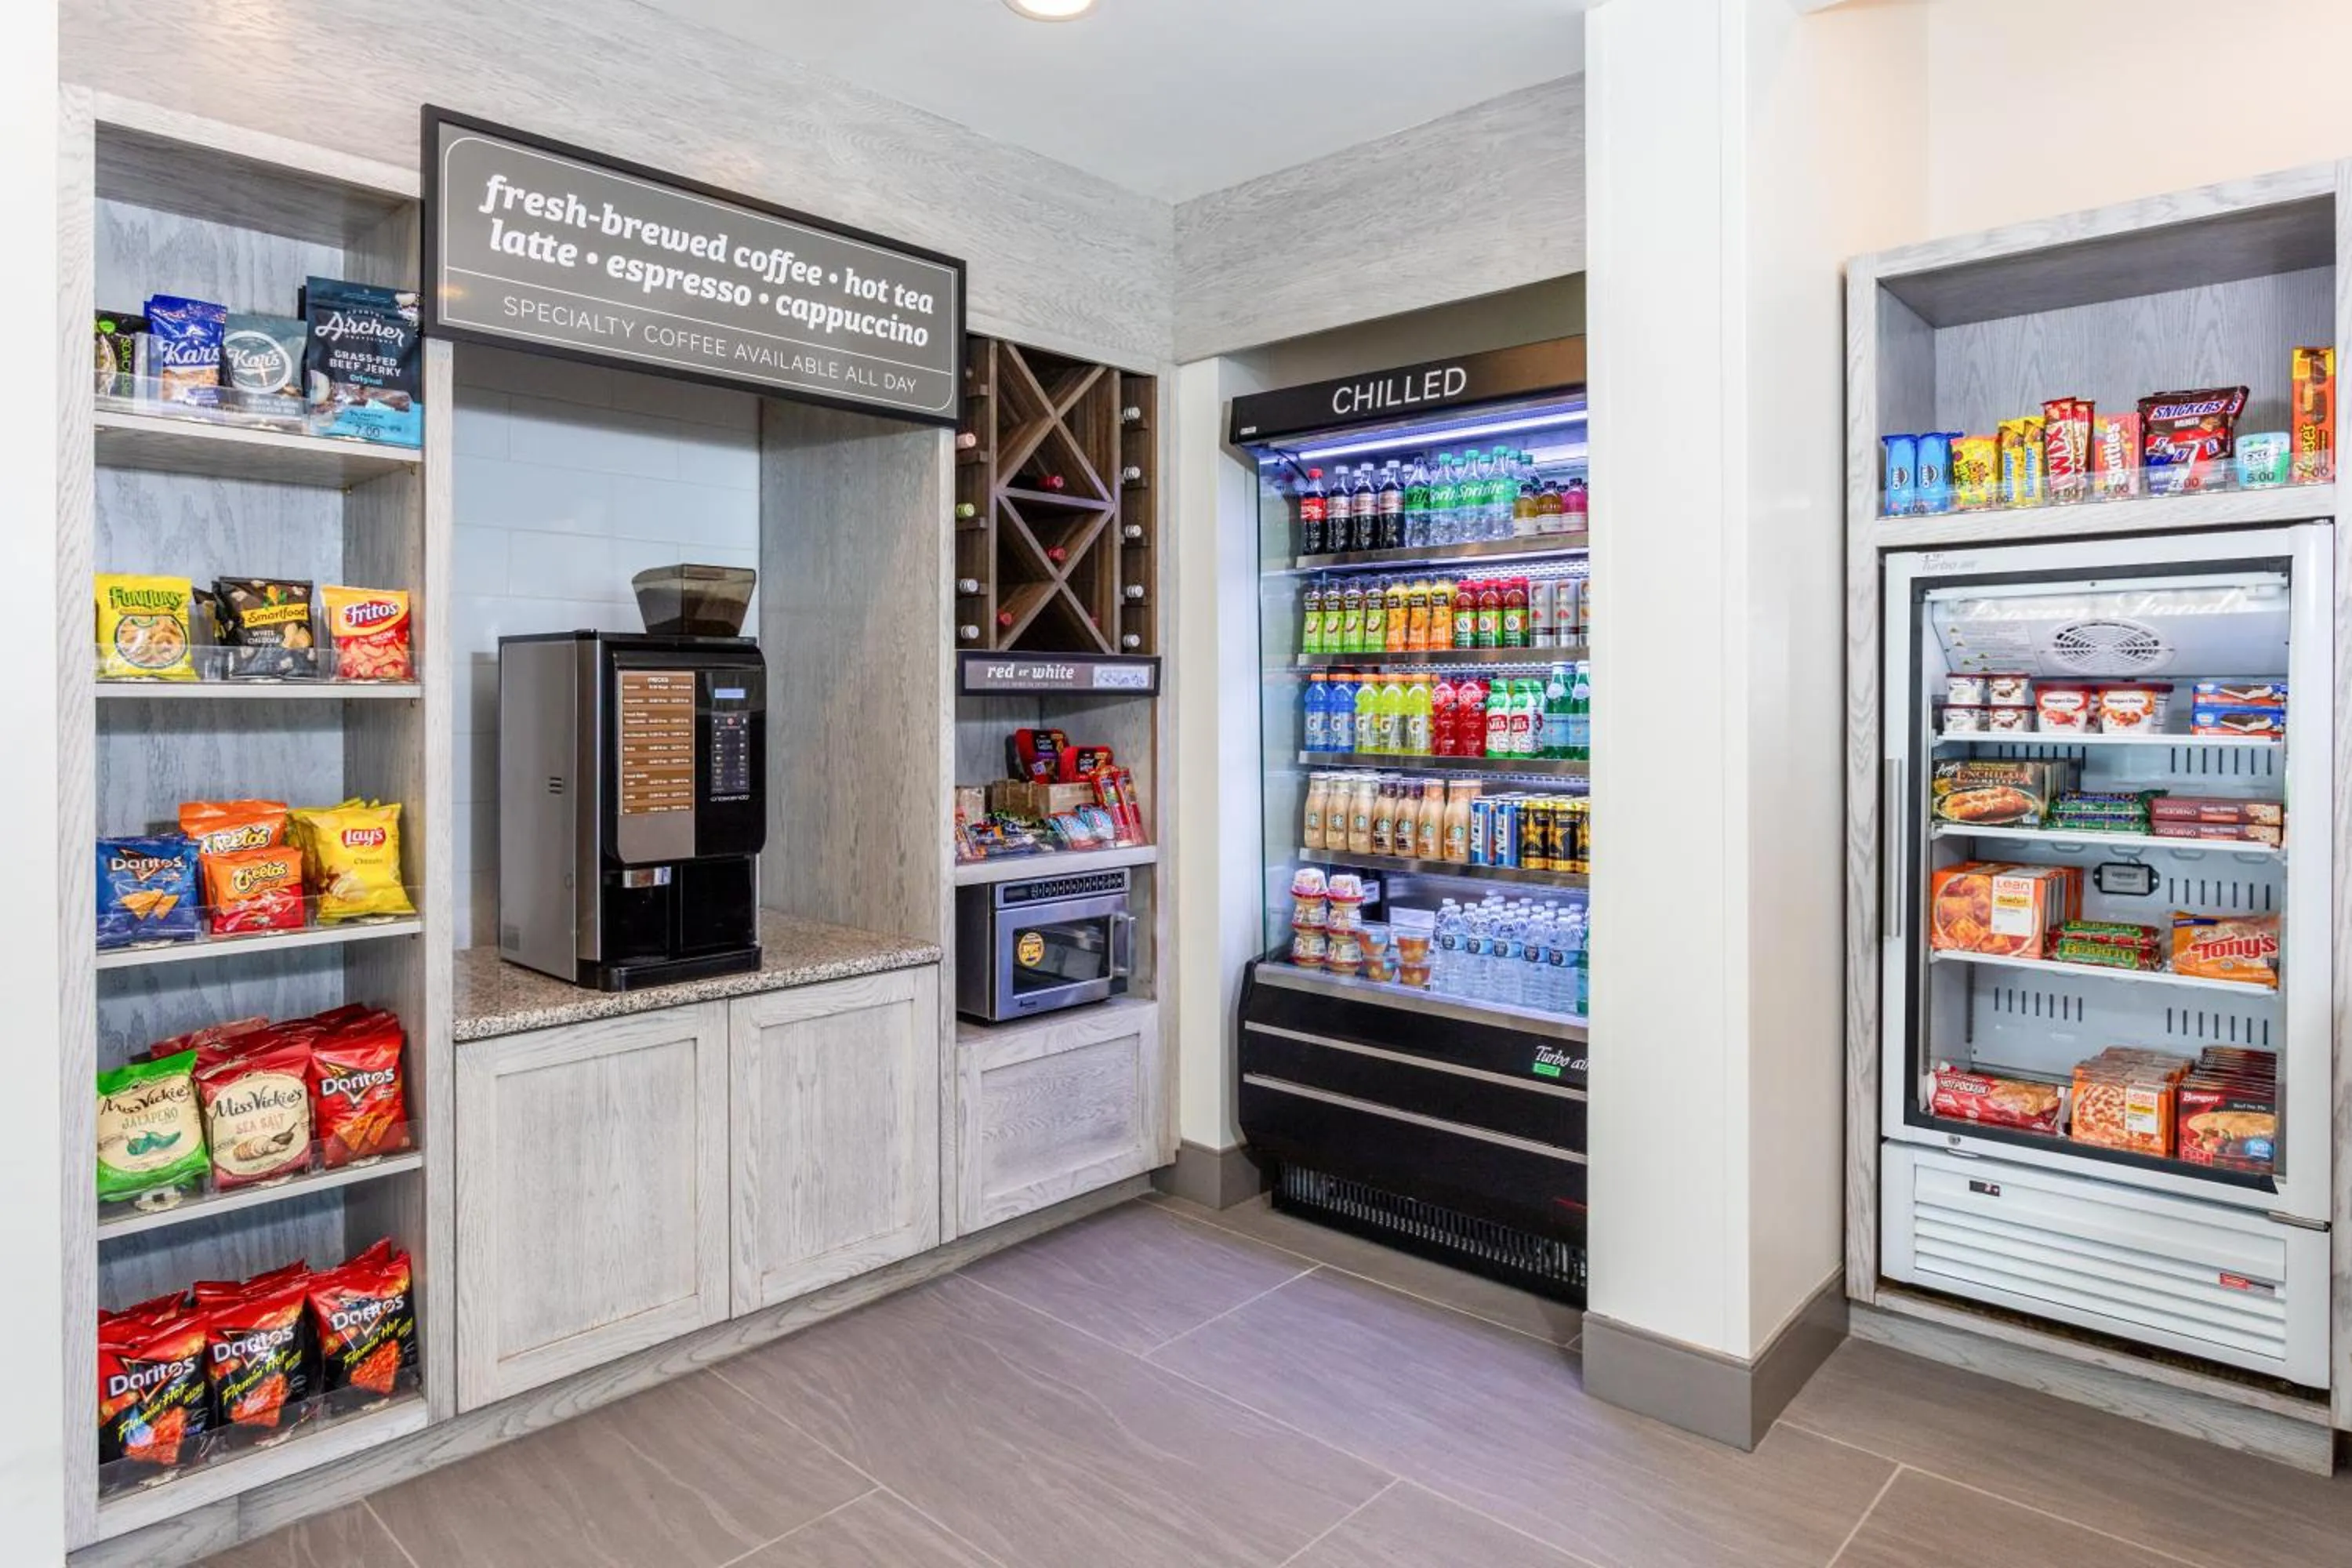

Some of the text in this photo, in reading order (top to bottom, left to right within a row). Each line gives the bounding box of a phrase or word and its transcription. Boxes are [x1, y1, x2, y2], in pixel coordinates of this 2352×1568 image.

[478, 174, 934, 314] fresh-brewed coffee hot tea
[489, 218, 928, 347] latte espresso cappuccino
[315, 311, 405, 347] Archer
[158, 340, 220, 364] Kar's
[503, 296, 917, 394] SPECIALTY COFFEE AVAILABLE ALL DAY
[329, 358, 401, 377] BEEF JERKY
[334, 350, 397, 366] GRASS-FED
[1333, 368, 1467, 414] CHILLED
[2155, 401, 2225, 418] SNICKERS
[2247, 472, 2274, 483] 5.00
[110, 586, 182, 611] FUNYUNS
[248, 608, 305, 624] Smartfood
[344, 602, 399, 626] Fritos
[987, 664, 1014, 678] red
[1032, 665, 1075, 679] white
[346, 828, 383, 847] Lay's
[111, 855, 183, 872] Doritos
[234, 864, 288, 891] Cheetos
[1996, 878, 2029, 890] Lean
[2189, 934, 2278, 960] Tony's
[1536, 1045, 1570, 1066] Turbo
[321, 1067, 394, 1096] Doritos
[212, 1085, 303, 1120] Miss Vickie's
[122, 1106, 179, 1131] JALAPEÑO
[237, 1113, 285, 1134] SEA SALT
[332, 1296, 405, 1330] Doritos
[213, 1326, 295, 1363] Doritos
[109, 1357, 196, 1396] Doritos
